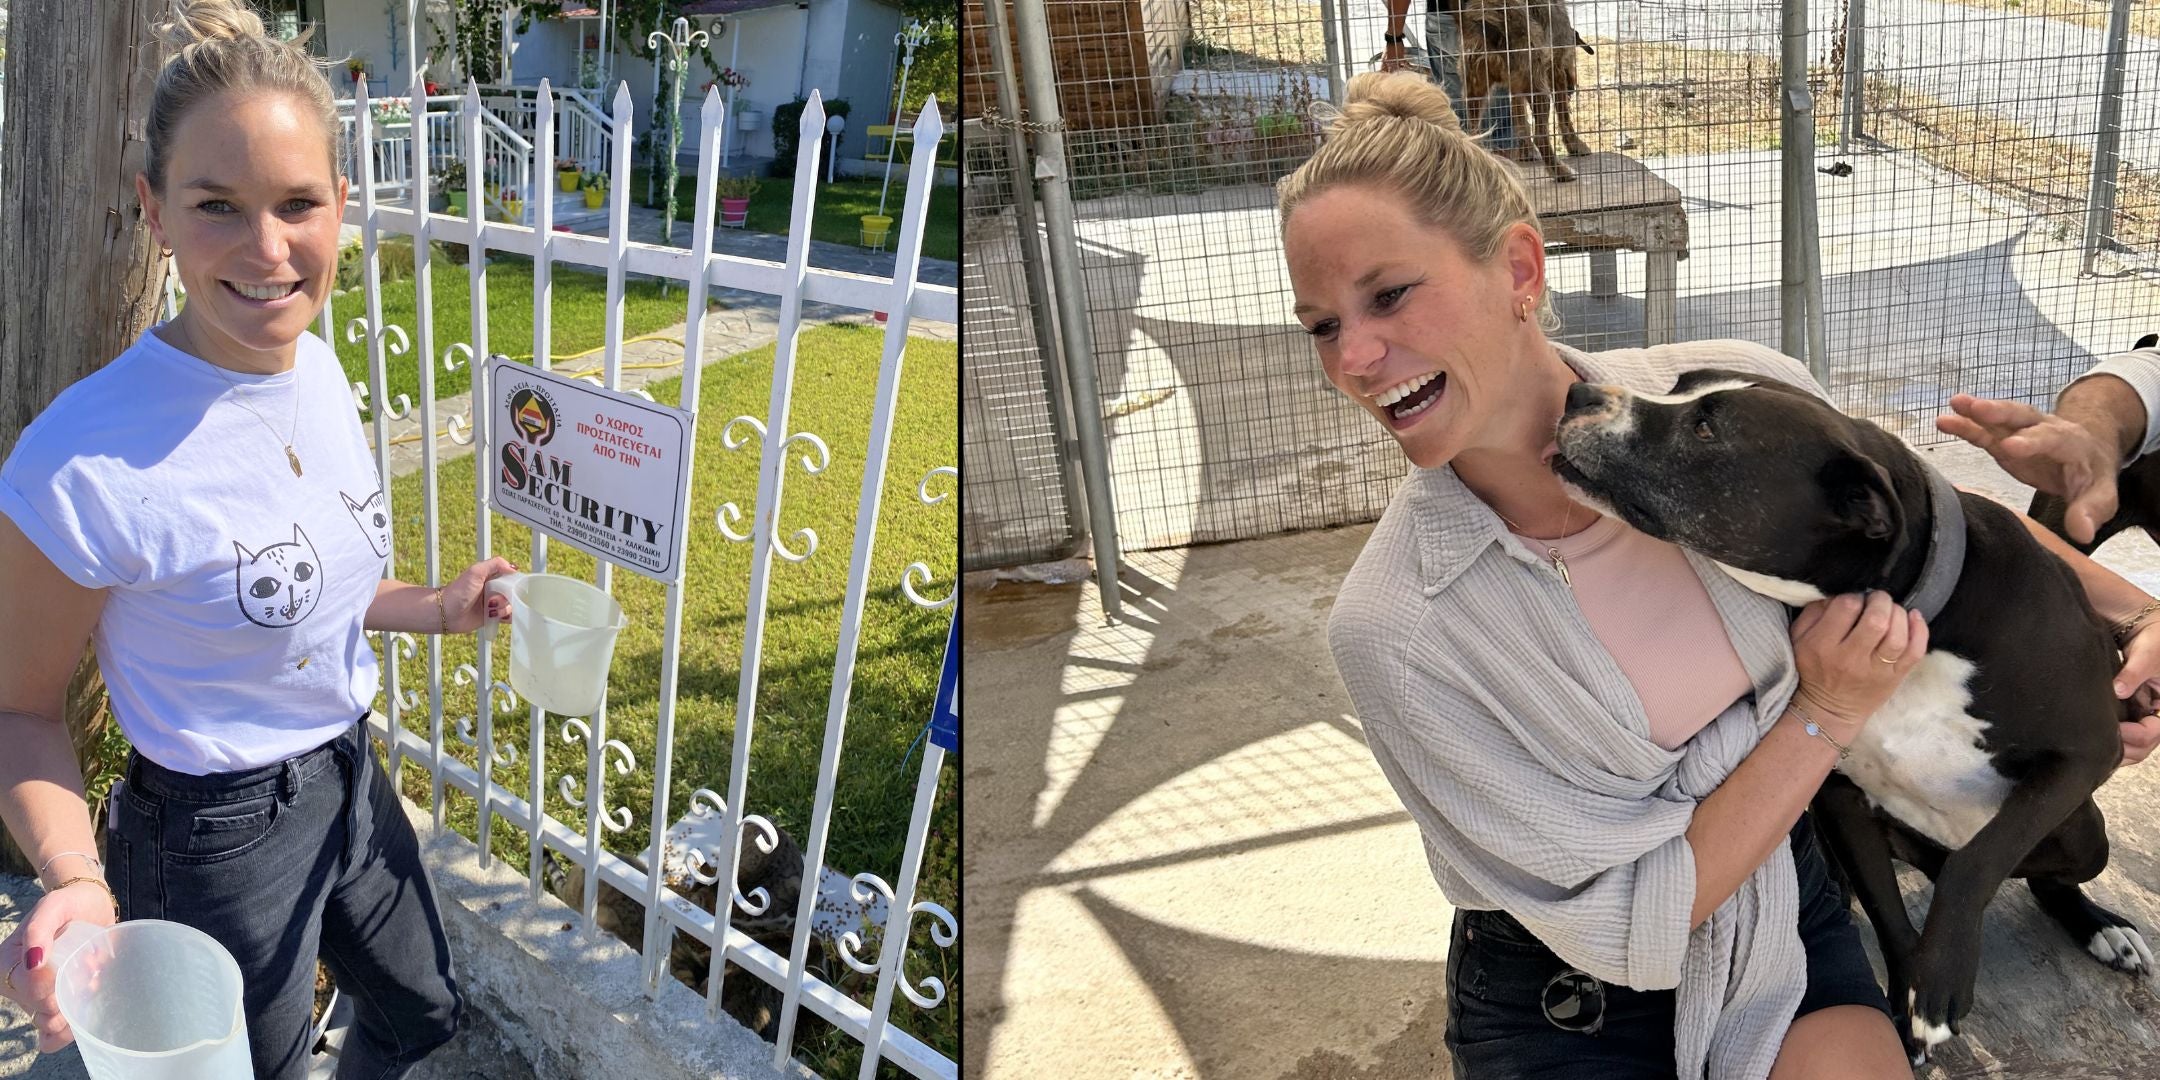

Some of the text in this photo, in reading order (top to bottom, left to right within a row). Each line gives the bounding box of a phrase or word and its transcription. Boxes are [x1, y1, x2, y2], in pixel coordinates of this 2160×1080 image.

[595, 414, 643, 437] Ο ΧΩΡΟΣ
[577, 422, 662, 459] ΠΡΟΣΤΑΤΕΥΕΤΑΙ
[502, 441, 573, 490] SAM
[593, 443, 641, 468] ΑΠΟ ΤΗΝ
[625, 539, 660, 558] ΧΑΛΚΙΔΙΚΗ
